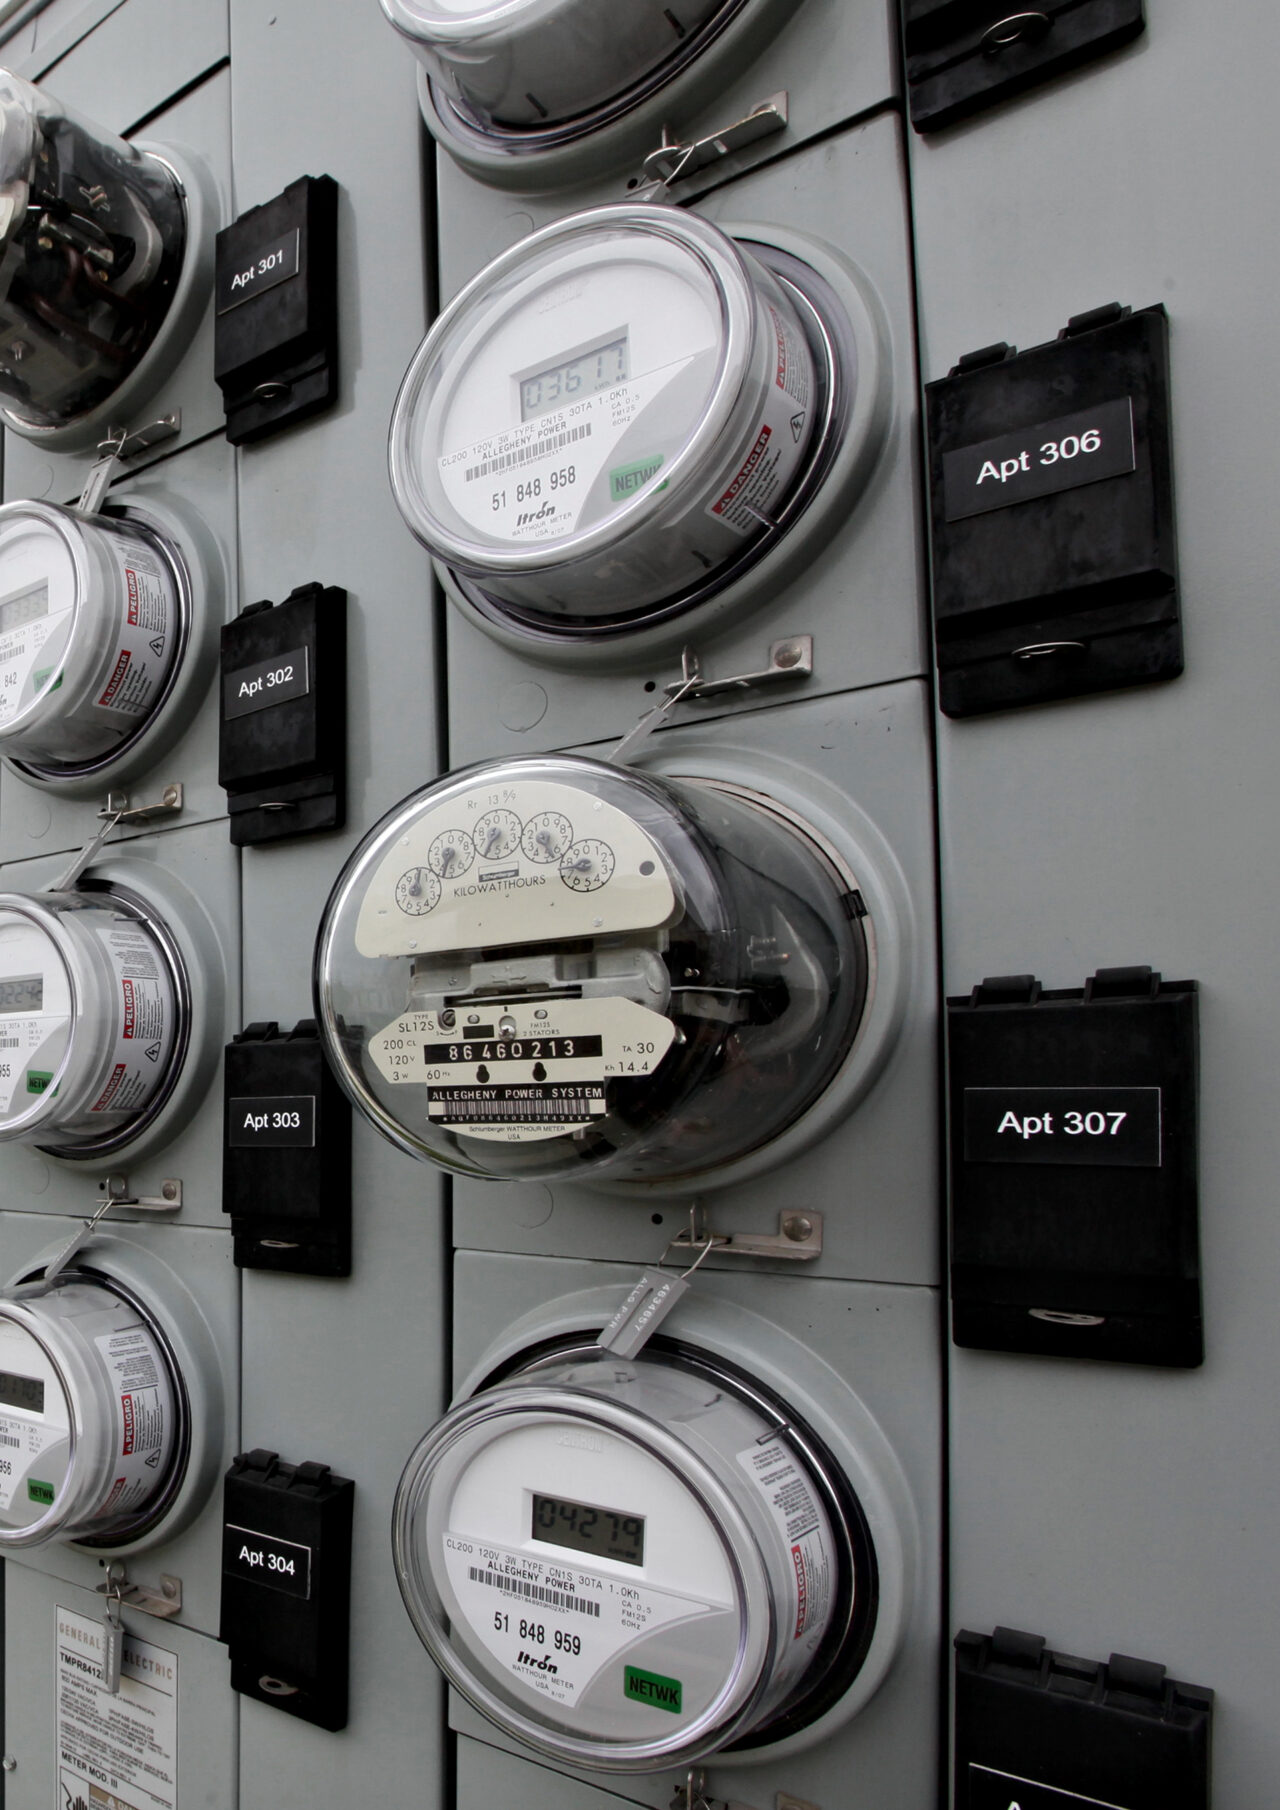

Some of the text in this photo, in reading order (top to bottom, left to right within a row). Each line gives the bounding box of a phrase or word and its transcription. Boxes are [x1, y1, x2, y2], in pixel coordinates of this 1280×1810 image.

[231, 250, 284, 290] Apt 301
[482, 421, 567, 460] ALLEGHENY POWER
[515, 423, 535, 437] TYPE
[730, 433, 770, 493] DANGER
[977, 428, 1102, 486] Apt 306
[492, 465, 576, 511] 51 848 958
[128, 571, 136, 614] PELIGRO
[108, 654, 129, 696] DANGER
[238, 666, 294, 698] Apt 302
[453, 874, 546, 897] KILOWATTHOURS
[124, 982, 133, 1027] PELIGRO
[398, 1021, 435, 1033] SL12S
[383, 1039, 404, 1050] 200
[388, 1055, 409, 1065] 120
[449, 1040, 575, 1060] 86 460 213
[637, 1042, 655, 1054] 30
[393, 1071, 400, 1081] 3
[426, 1069, 441, 1080] 60
[618, 1061, 649, 1073] 14.4
[101, 1065, 124, 1103] DANGER
[432, 1087, 602, 1101] ALLEGHENY POWER SYSTEM
[243, 1112, 301, 1132] Apt 303
[997, 1110, 1127, 1139] Apt 307
[123, 1398, 133, 1444] PELIGRO
[31, 1485, 54, 1500] NETWK
[538, 1499, 642, 1547] 04279
[239, 1545, 295, 1576] Apt 304
[446, 1538, 640, 1601] CL200 120V 3W TYPE CN1S 30TA 1.0Kh
[488, 1561, 575, 1593] ALLEGHENY POWER
[793, 1551, 807, 1620] PELIGRO
[622, 1600, 633, 1609] CA
[494, 1611, 581, 1656] 51 848 959
[60, 1622, 101, 1650] GENERAL
[124, 1650, 172, 1680] ELECTRIC
[512, 1664, 574, 1690] WATTHOUR METER
[535, 1680, 549, 1691] USA
[629, 1676, 679, 1707] NETWK
[62, 1751, 87, 1772] METER
[89, 1766, 109, 1785] MOD.
